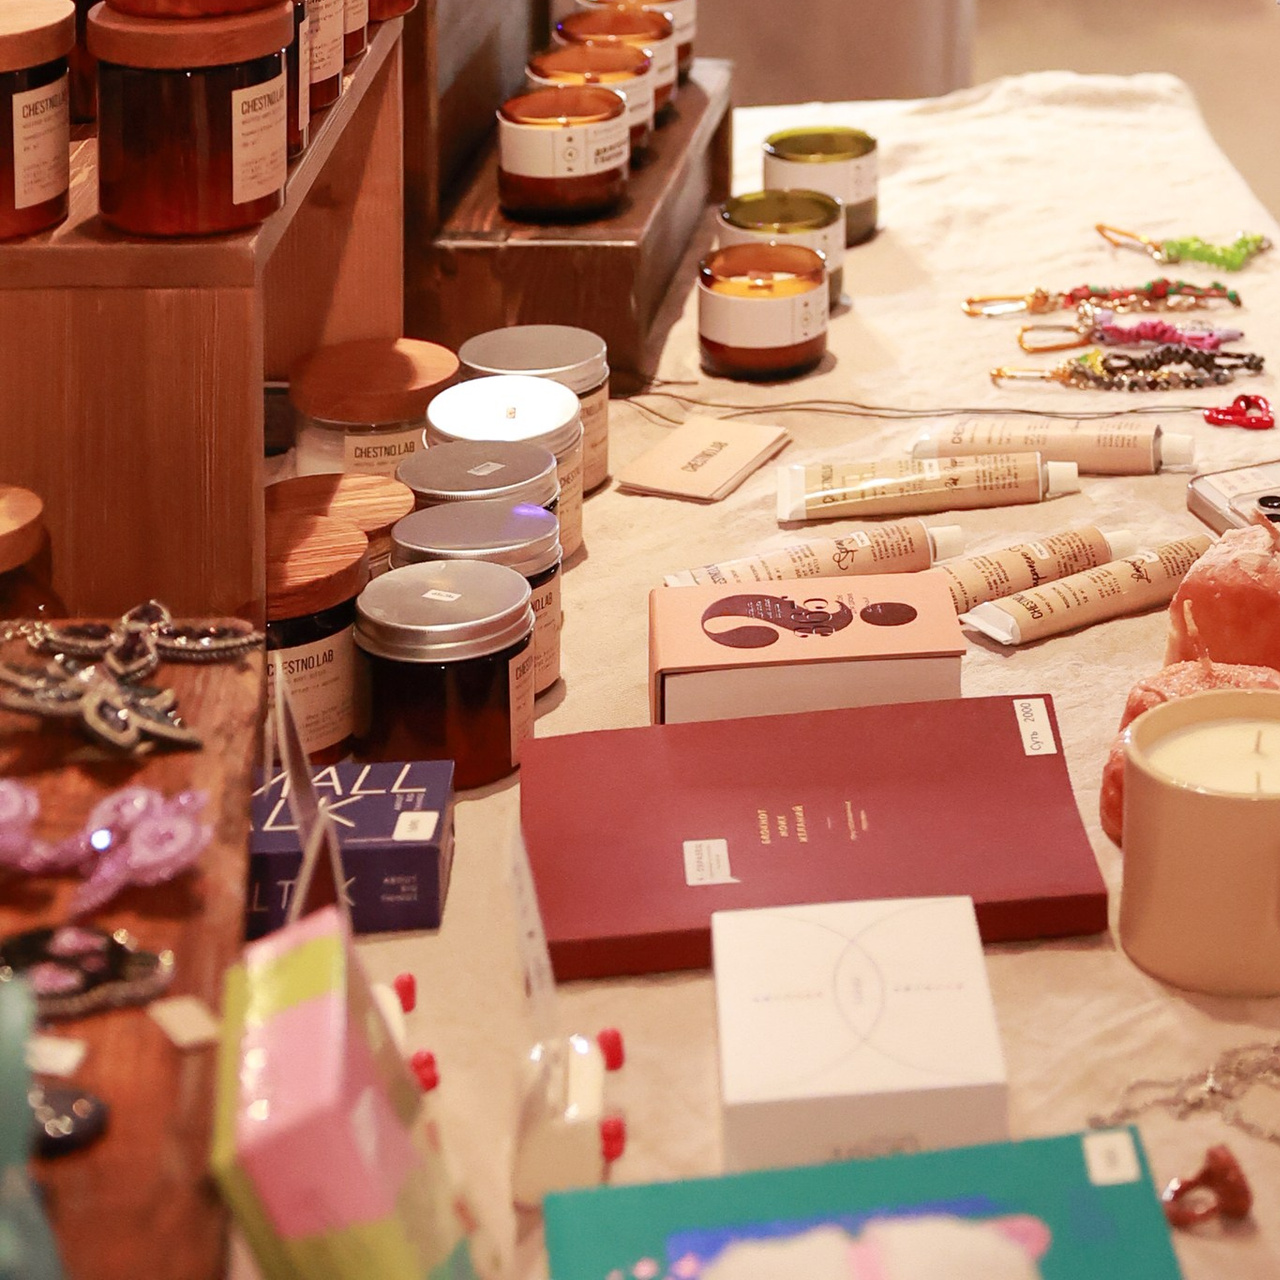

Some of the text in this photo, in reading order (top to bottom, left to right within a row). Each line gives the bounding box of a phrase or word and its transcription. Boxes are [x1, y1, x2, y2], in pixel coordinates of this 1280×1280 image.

[1020, 702, 1044, 750] Суть 2000
[757, 809, 772, 844] БЛОКНОТ
[777, 815, 789, 837] МОИХ
